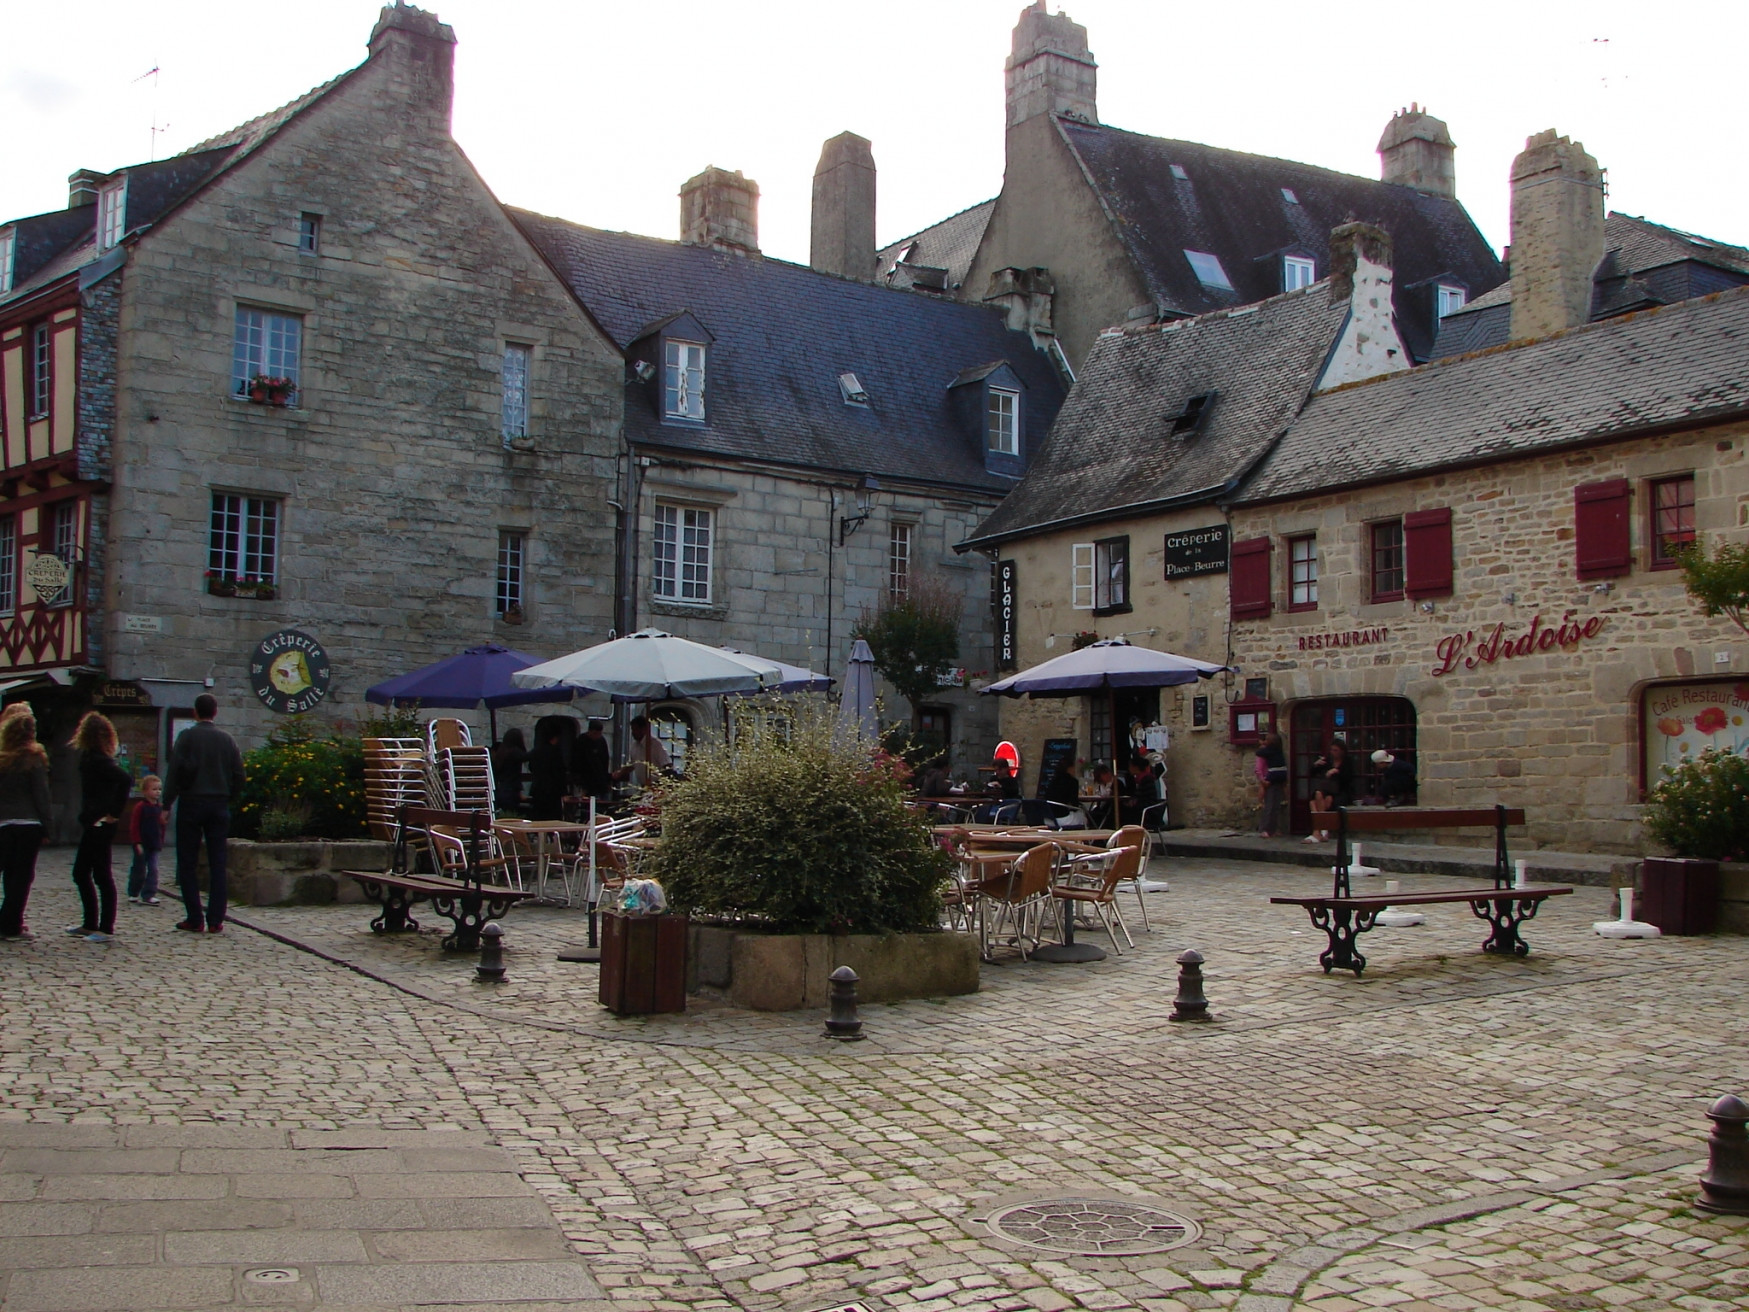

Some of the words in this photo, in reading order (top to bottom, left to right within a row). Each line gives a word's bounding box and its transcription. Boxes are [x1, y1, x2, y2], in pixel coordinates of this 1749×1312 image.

[1002, 566, 1011, 660] GLACIER
[261, 633, 321, 657] Crêperie
[1299, 627, 1388, 651] RESTAURANT
[1431, 614, 1609, 677] L'Ardoise
[258, 685, 276, 706] du
[1652, 694, 1679, 716] Café
